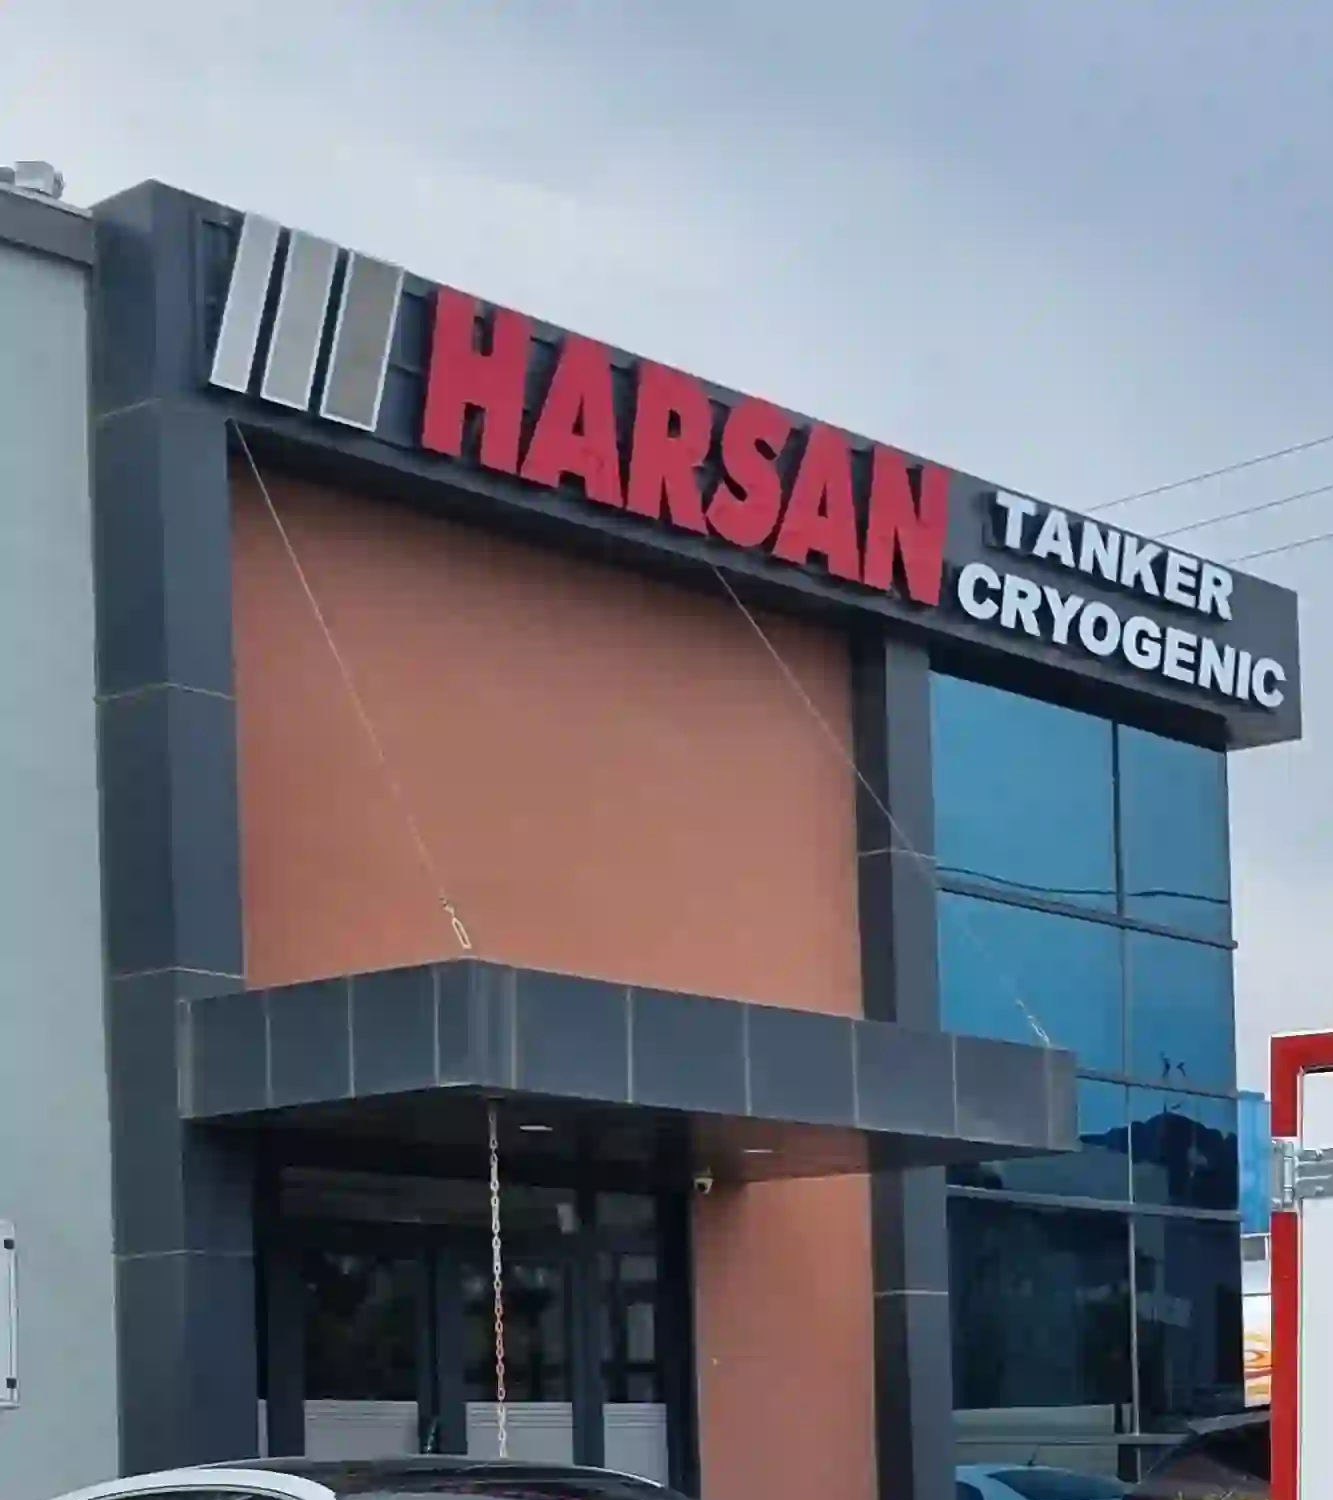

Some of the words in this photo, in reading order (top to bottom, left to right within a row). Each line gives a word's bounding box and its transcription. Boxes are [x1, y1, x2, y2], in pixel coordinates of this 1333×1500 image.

[422, 284, 950, 606] HARSAN
[996, 490, 1233, 621] TANKER
[957, 562, 1287, 708] CRYOGENIC
